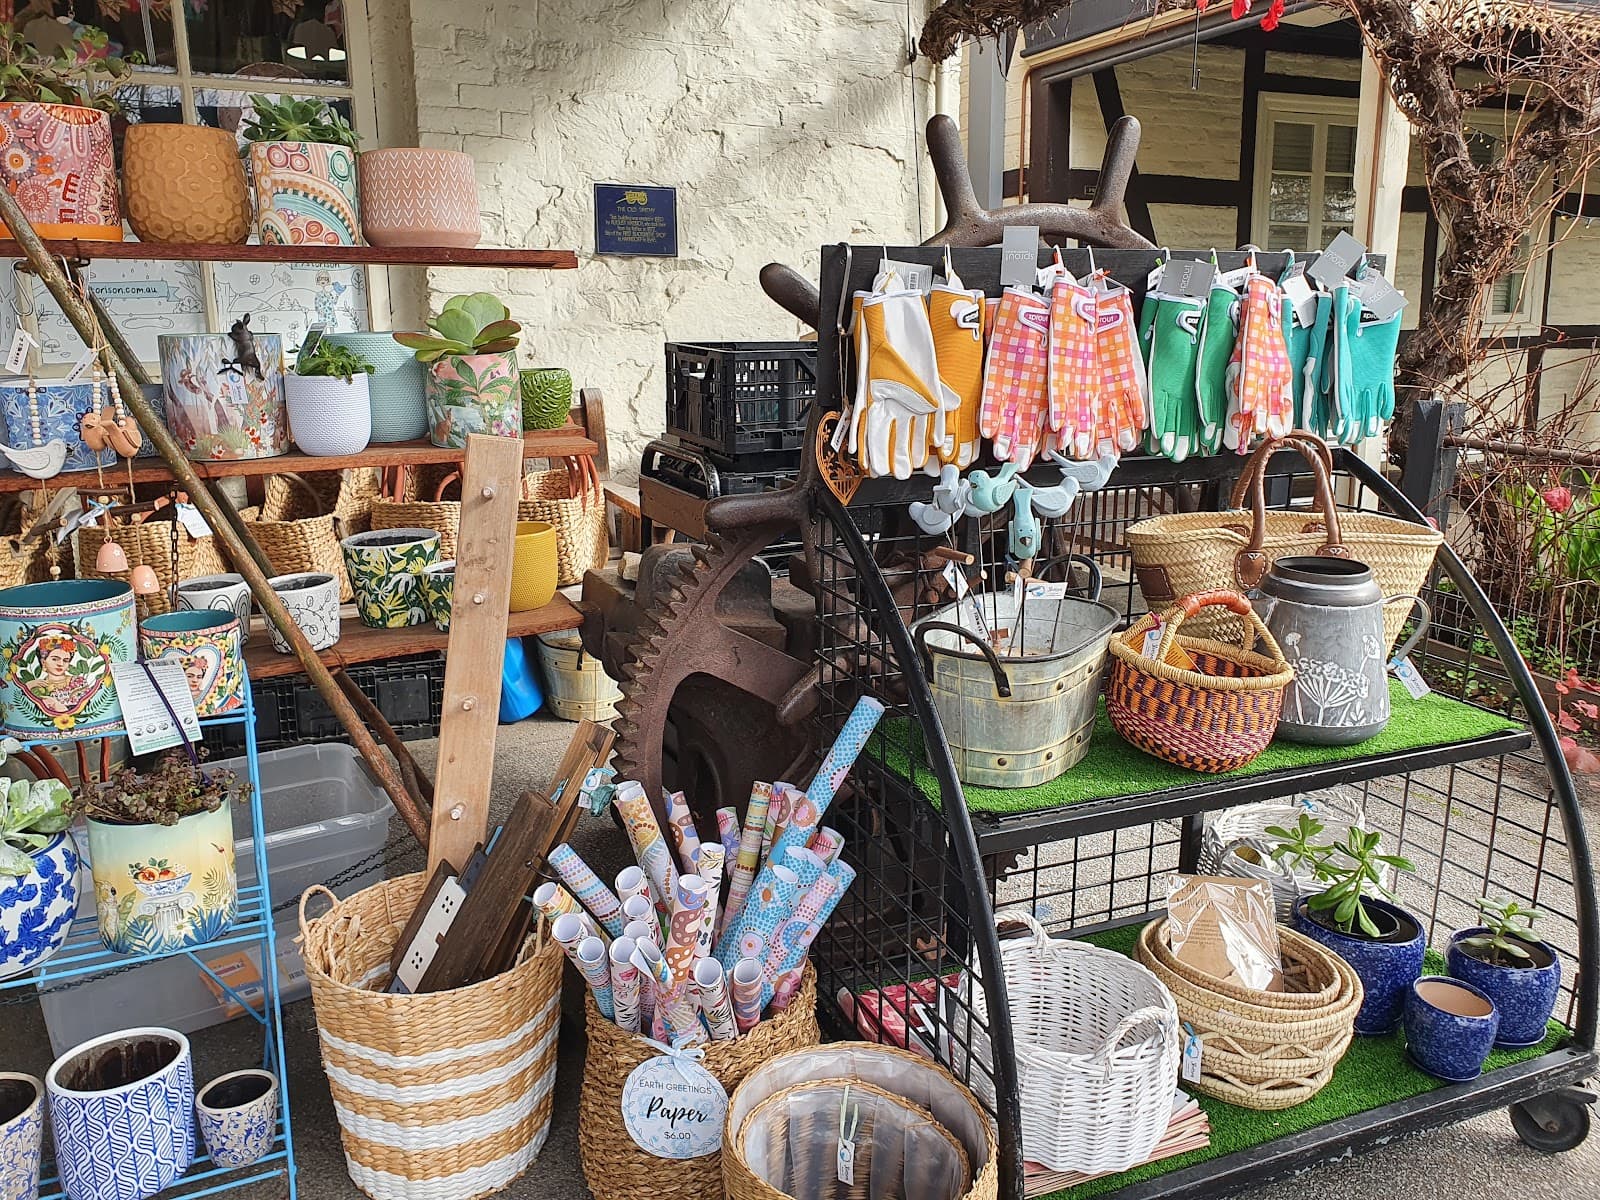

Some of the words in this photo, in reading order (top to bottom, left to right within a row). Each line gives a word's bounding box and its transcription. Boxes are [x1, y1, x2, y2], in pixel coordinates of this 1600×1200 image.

[639, 1080, 664, 1090] EARTH
[666, 1083, 712, 1095] GREETINGS
[646, 1096, 708, 1129] Paper
[663, 1131, 691, 1140] $6.00
